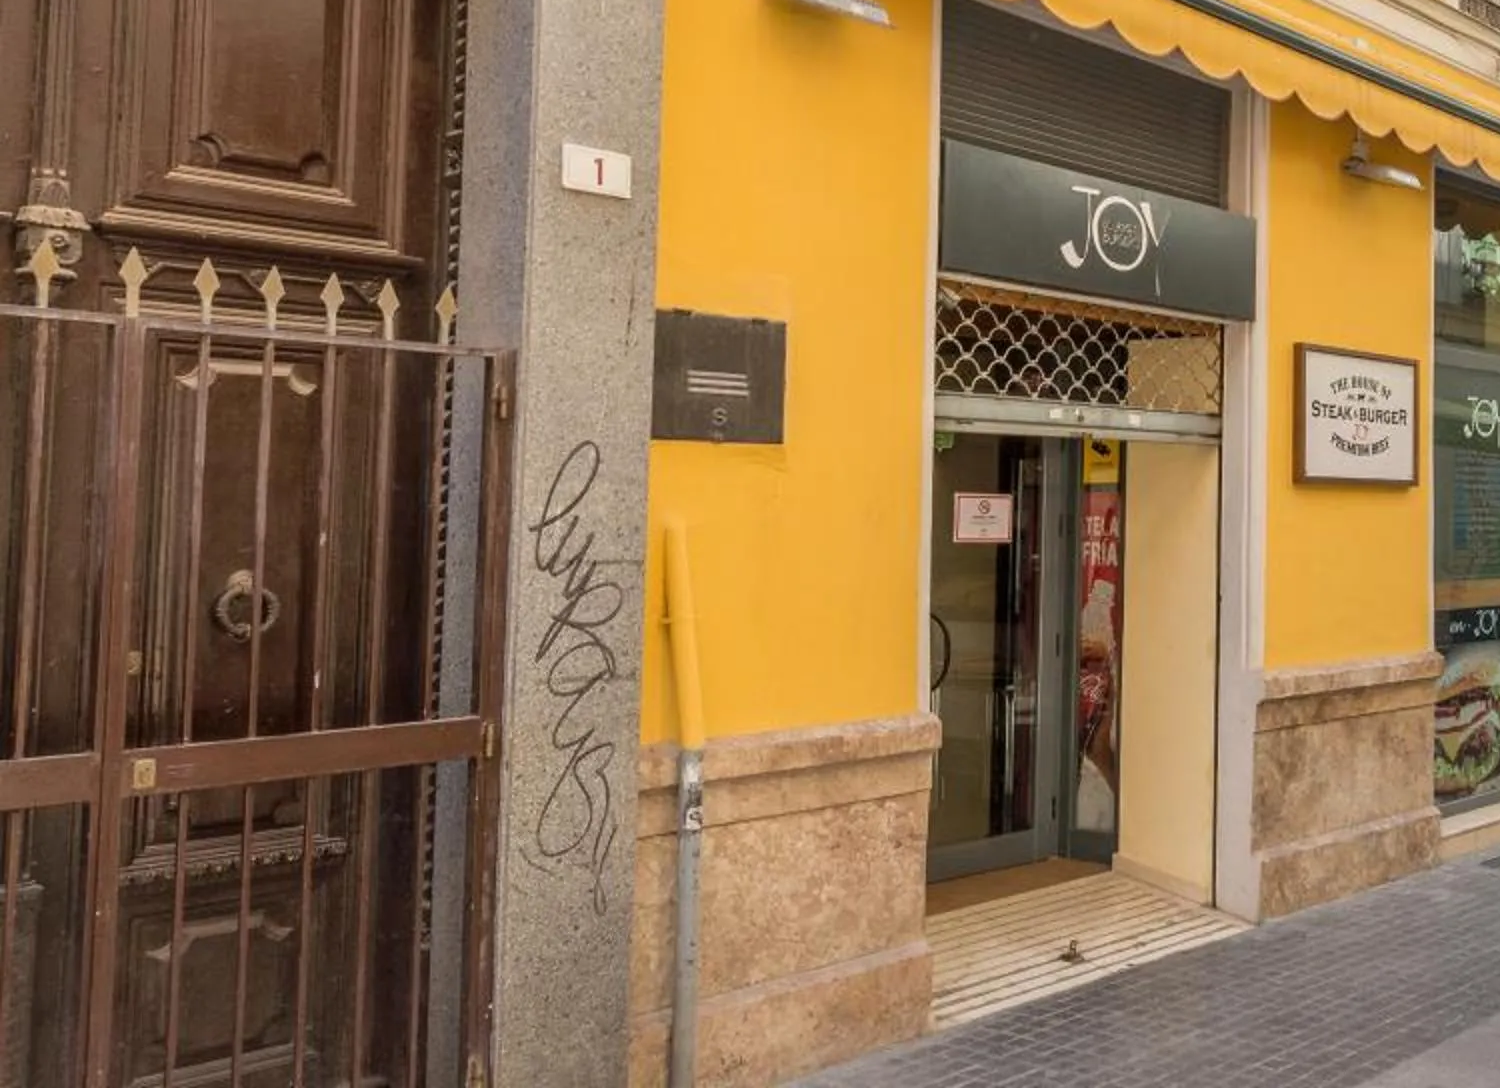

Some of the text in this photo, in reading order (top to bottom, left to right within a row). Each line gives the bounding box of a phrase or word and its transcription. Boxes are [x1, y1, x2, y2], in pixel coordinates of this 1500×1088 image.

[593, 157, 604, 186] 1
[1060, 185, 1172, 297] JOY
[711, 406, 728, 427] S
[1311, 399, 1353, 421] STEAK
[1359, 407, 1408, 426] BURGER
